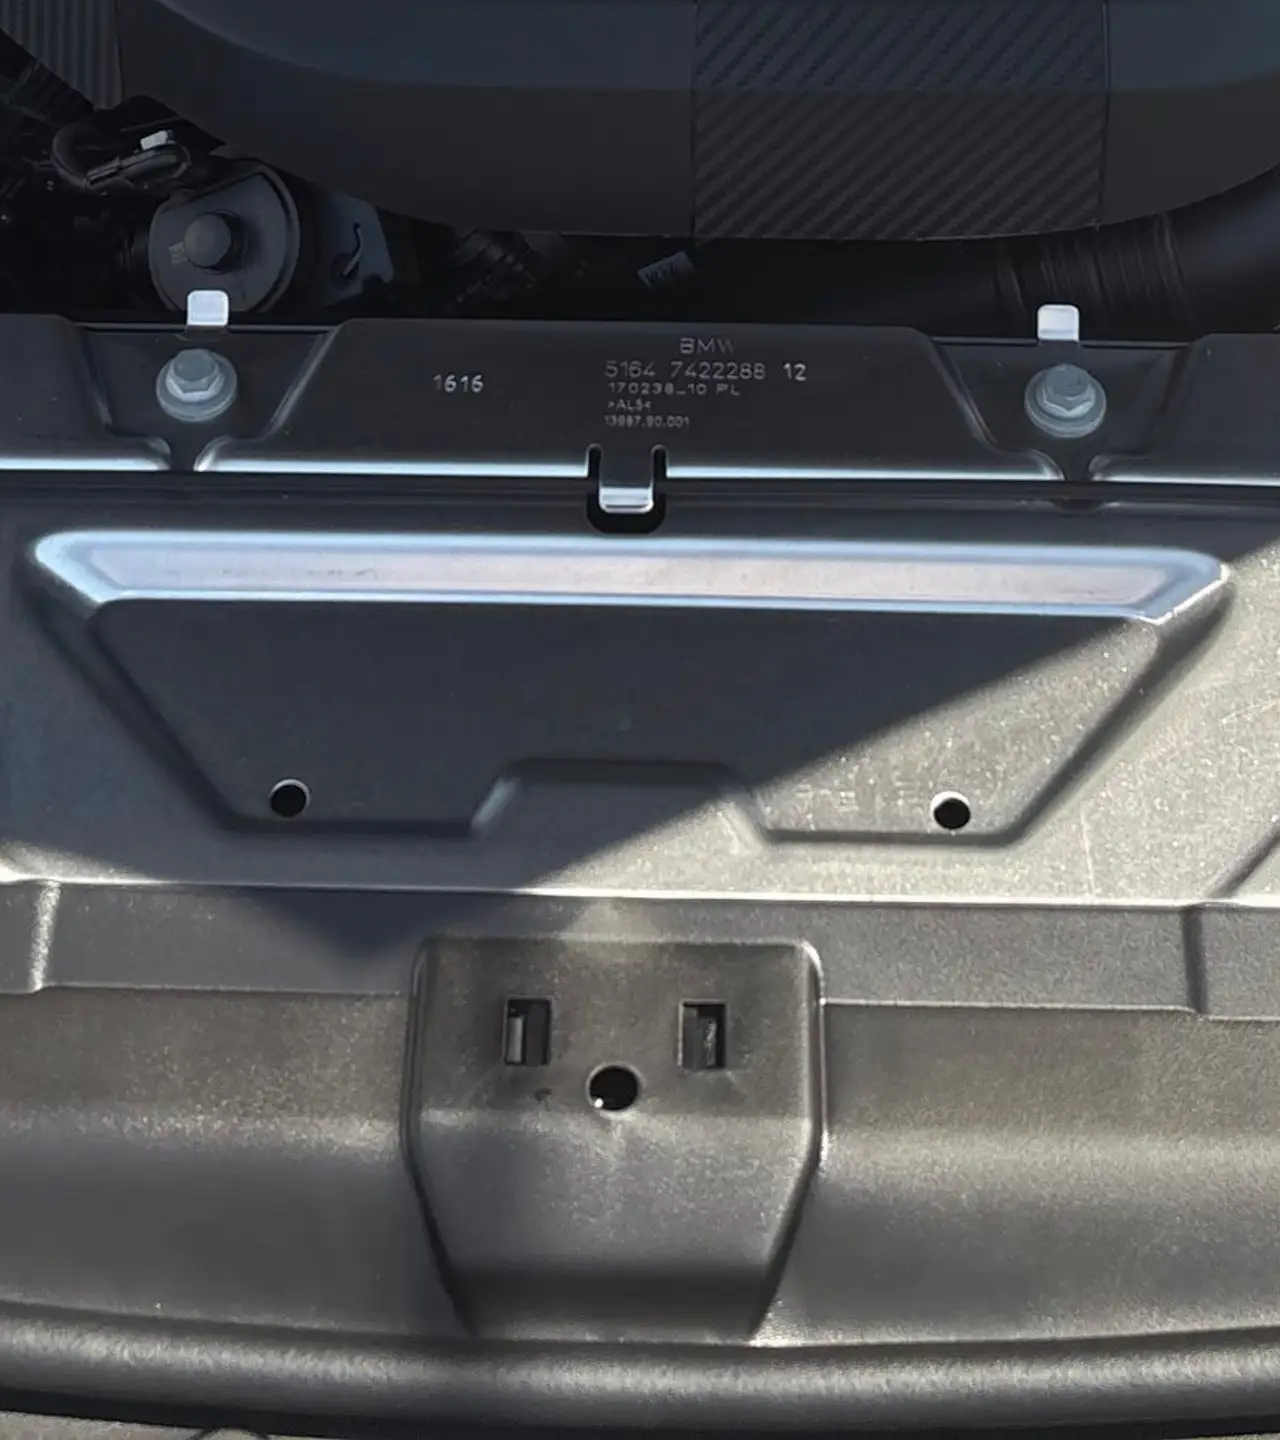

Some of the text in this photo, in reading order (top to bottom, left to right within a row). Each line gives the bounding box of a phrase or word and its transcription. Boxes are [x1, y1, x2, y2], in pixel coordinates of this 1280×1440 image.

[679, 336, 736, 355] BMW
[604, 360, 808, 382] 5164 7422288 12
[432, 373, 484, 394] 1616
[715, 383, 742, 397] PL
